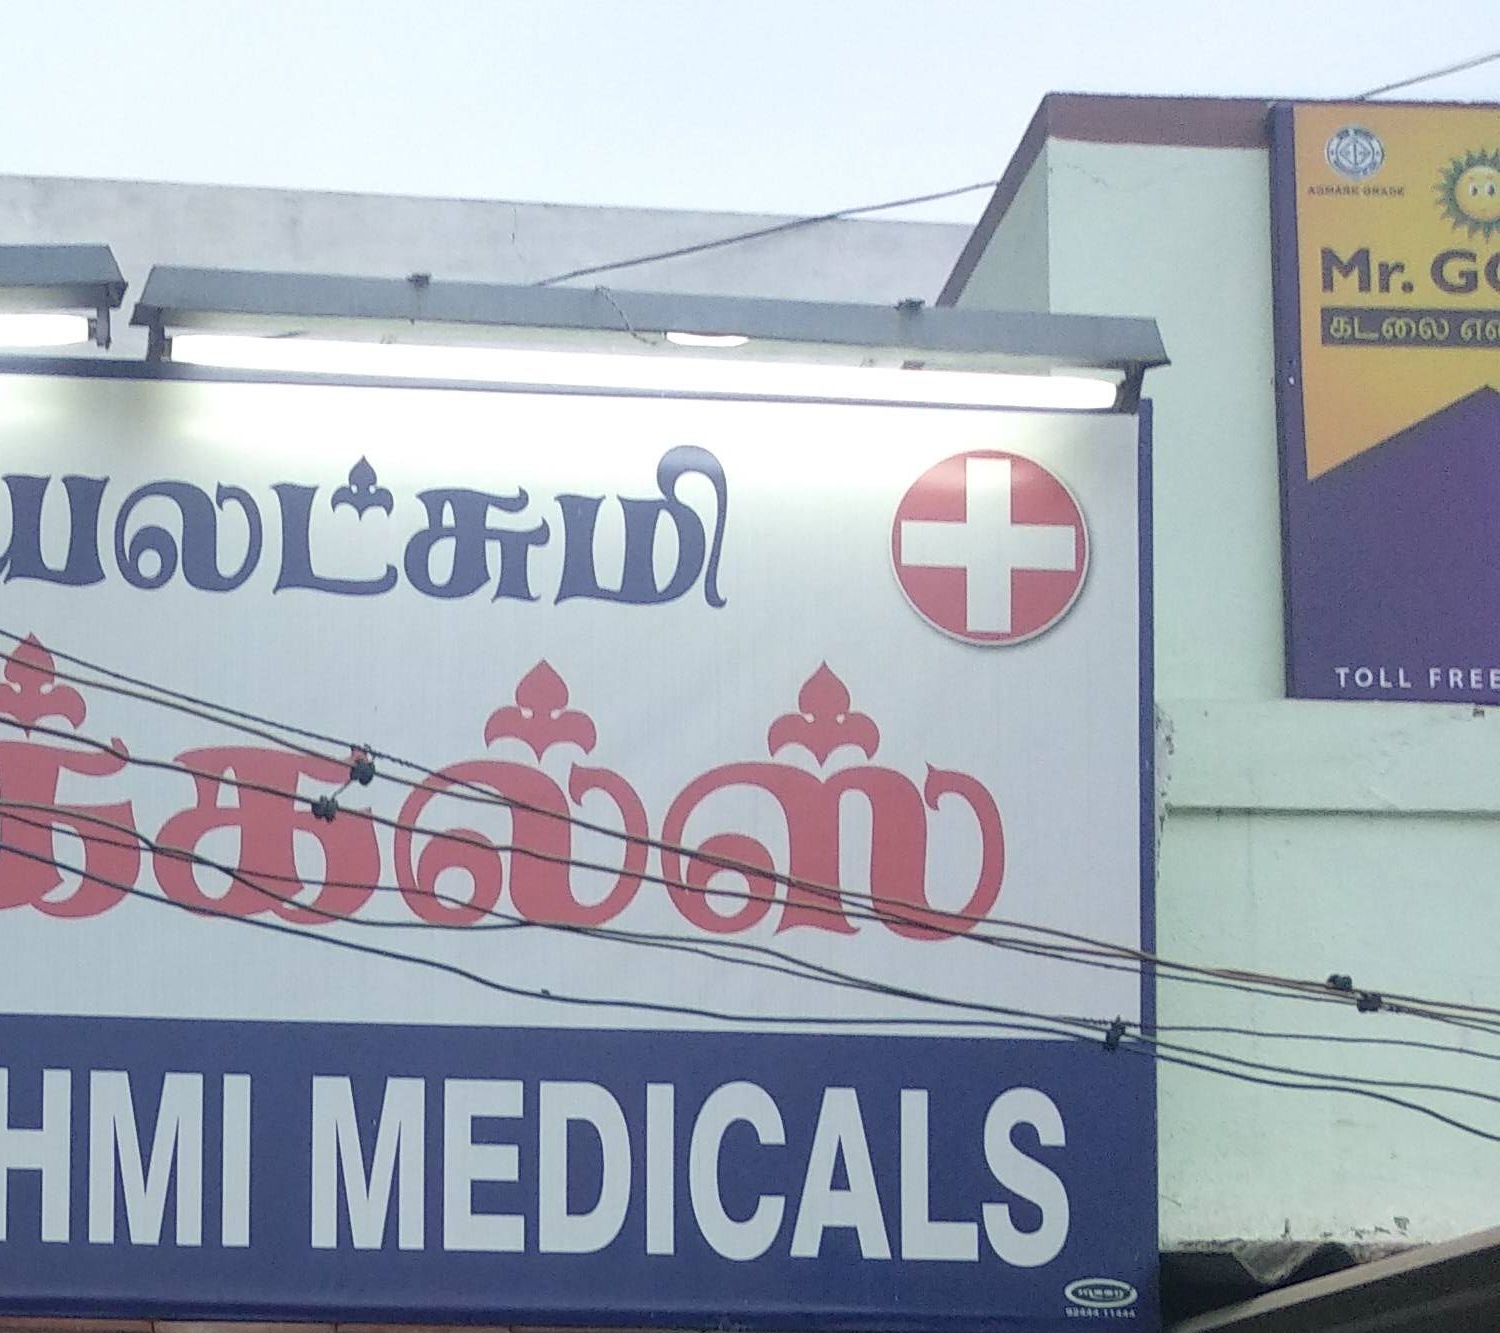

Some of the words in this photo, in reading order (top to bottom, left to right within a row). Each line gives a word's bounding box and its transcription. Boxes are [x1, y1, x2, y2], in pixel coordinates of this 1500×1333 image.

[1321, 247, 1414, 294] Mr.
[1330, 316, 1449, 343] கடலை
[1335, 667, 1412, 688] TOLL
[1430, 667, 1500, 689] FREE
[311, 1075, 1070, 1267] MEDICALS
